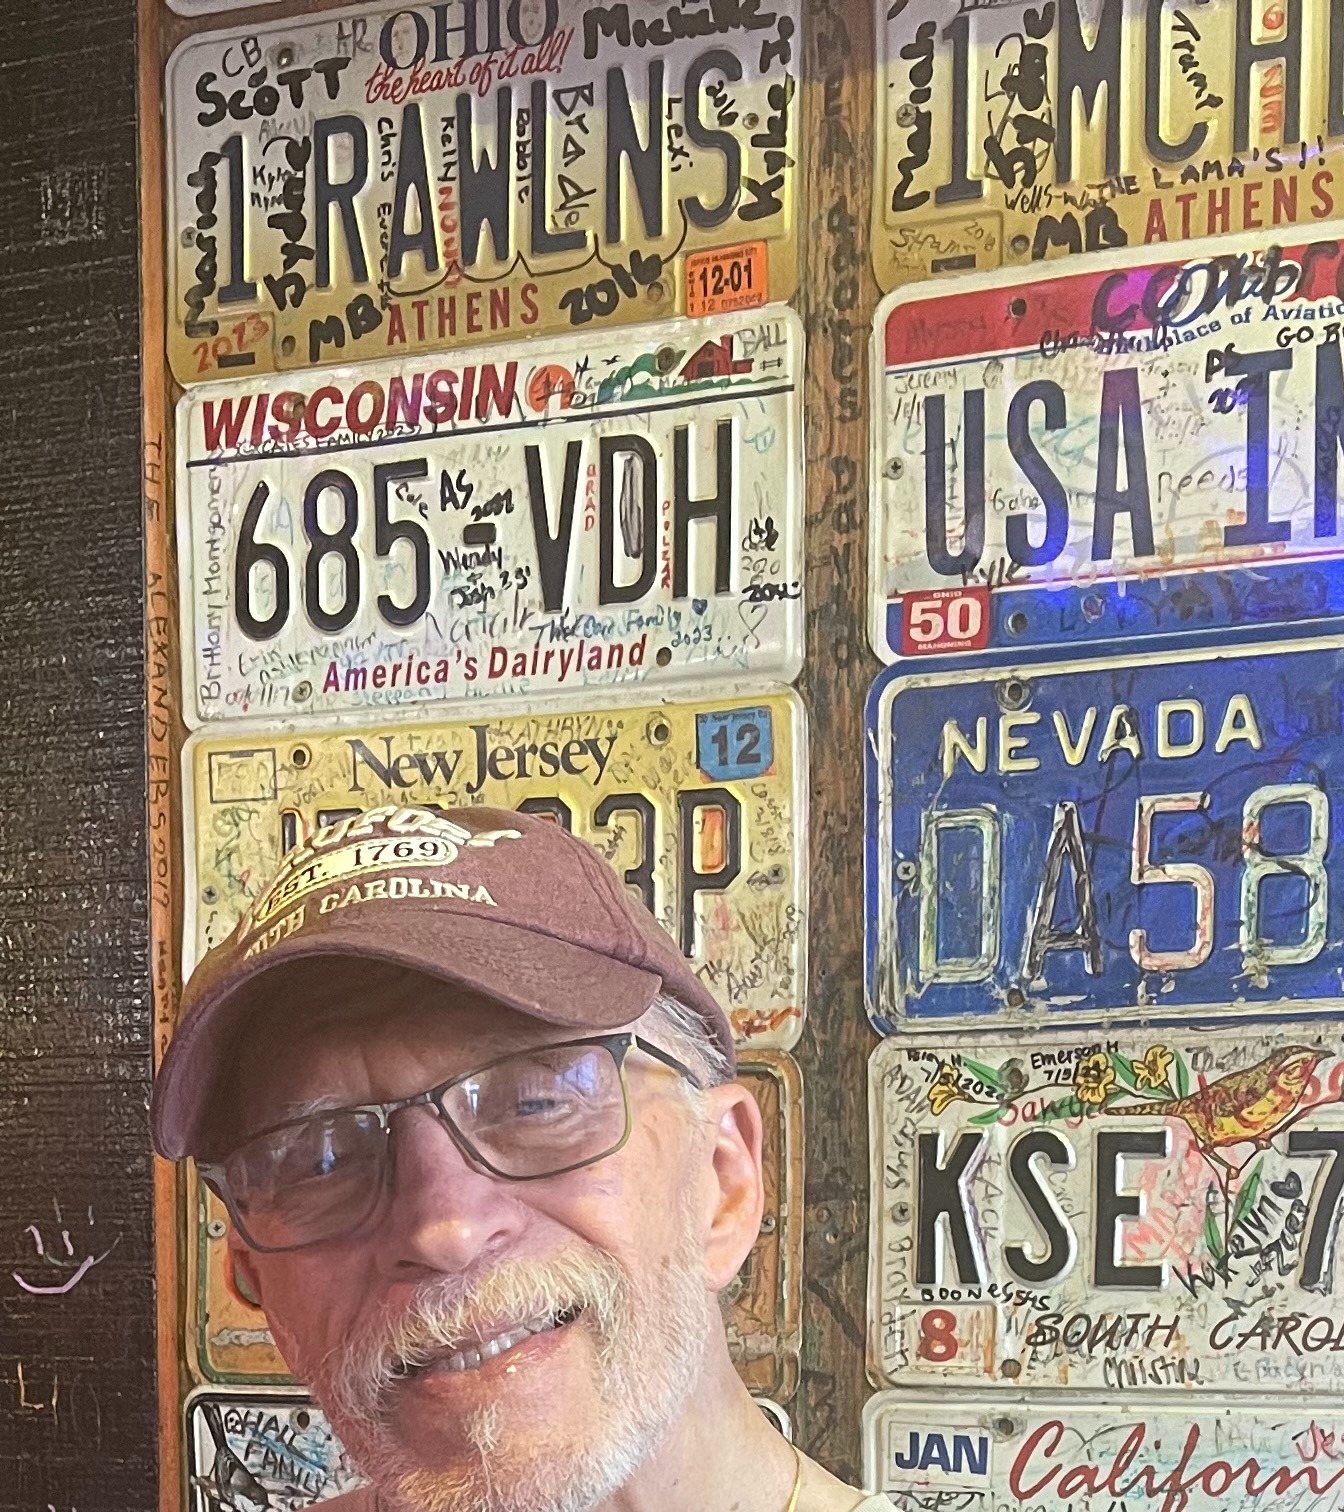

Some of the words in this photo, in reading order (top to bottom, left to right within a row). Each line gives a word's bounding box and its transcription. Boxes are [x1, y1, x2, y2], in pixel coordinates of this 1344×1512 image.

[379, 0, 560, 71] OHIO
[364, 66, 407, 106] the
[409, 53, 464, 98] heart
[1144, 170, 1335, 245] ATHENS
[698, 257, 754, 299] 12-01
[386, 283, 540, 346] ATHENS
[202, 361, 518, 452] WISCONSIN
[924, 366, 1157, 577] USA
[234, 457, 432, 642] 685
[525, 419, 733, 613] VDH
[908, 596, 983, 645] 50
[322, 648, 478, 695] America's
[487, 632, 648, 684] Dairyland
[346, 735, 463, 794] New
[465, 723, 619, 795] Jersey
[711, 723, 762, 767] 12
[940, 694, 1262, 778] NEVADA
[352, 841, 440, 867] 1769
[319, 877, 499, 915] CAROLINA
[914, 1125, 1169, 1290] KSE
[918, 1307, 958, 1362] 8
[1025, 1311, 1182, 1352] SOUTH
[894, 1429, 990, 1477] JAN
